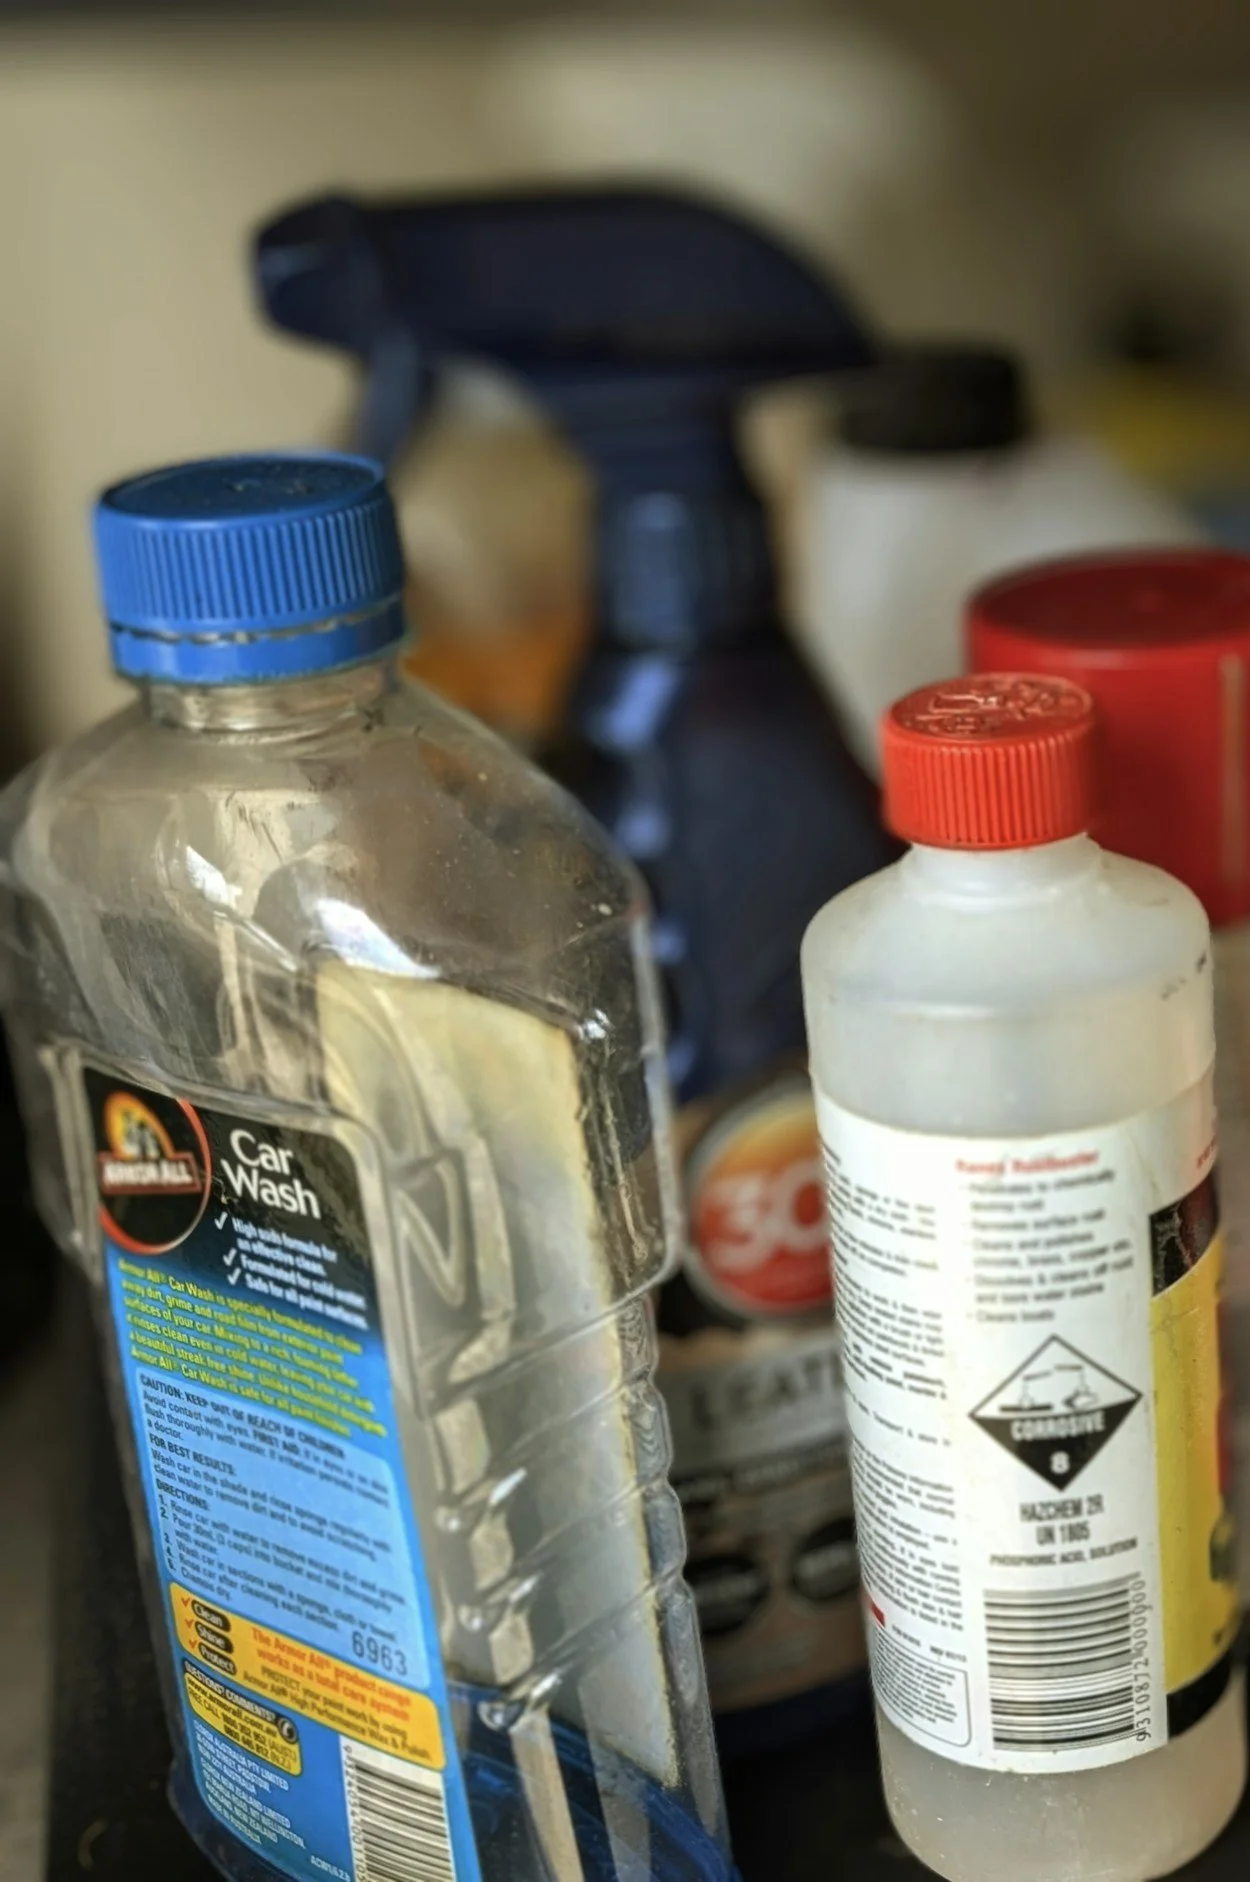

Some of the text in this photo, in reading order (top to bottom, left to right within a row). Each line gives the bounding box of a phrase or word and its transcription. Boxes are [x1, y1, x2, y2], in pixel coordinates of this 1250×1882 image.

[230, 1129, 293, 1174] Car
[160, 1160, 193, 1183] ALL
[221, 1158, 321, 1219] Wash
[139, 1373, 184, 1401] CAUTION:
[185, 1390, 208, 1409] KEEP
[690, 1350, 845, 1430] LEAT
[1010, 1412, 1106, 1441] CORROSIVE
[149, 1433, 166, 1449] FOR
[167, 1440, 190, 1458] BEST
[1051, 1452, 1069, 1473] 8
[1019, 1496, 1084, 1522] HAZCHEM
[1036, 1525, 1056, 1546] UN
[193, 1603, 222, 1626] Clean
[196, 1624, 225, 1649] Shine
[251, 1627, 271, 1647] The
[199, 1644, 234, 1673] Protect
[351, 1629, 407, 1677] 6963
